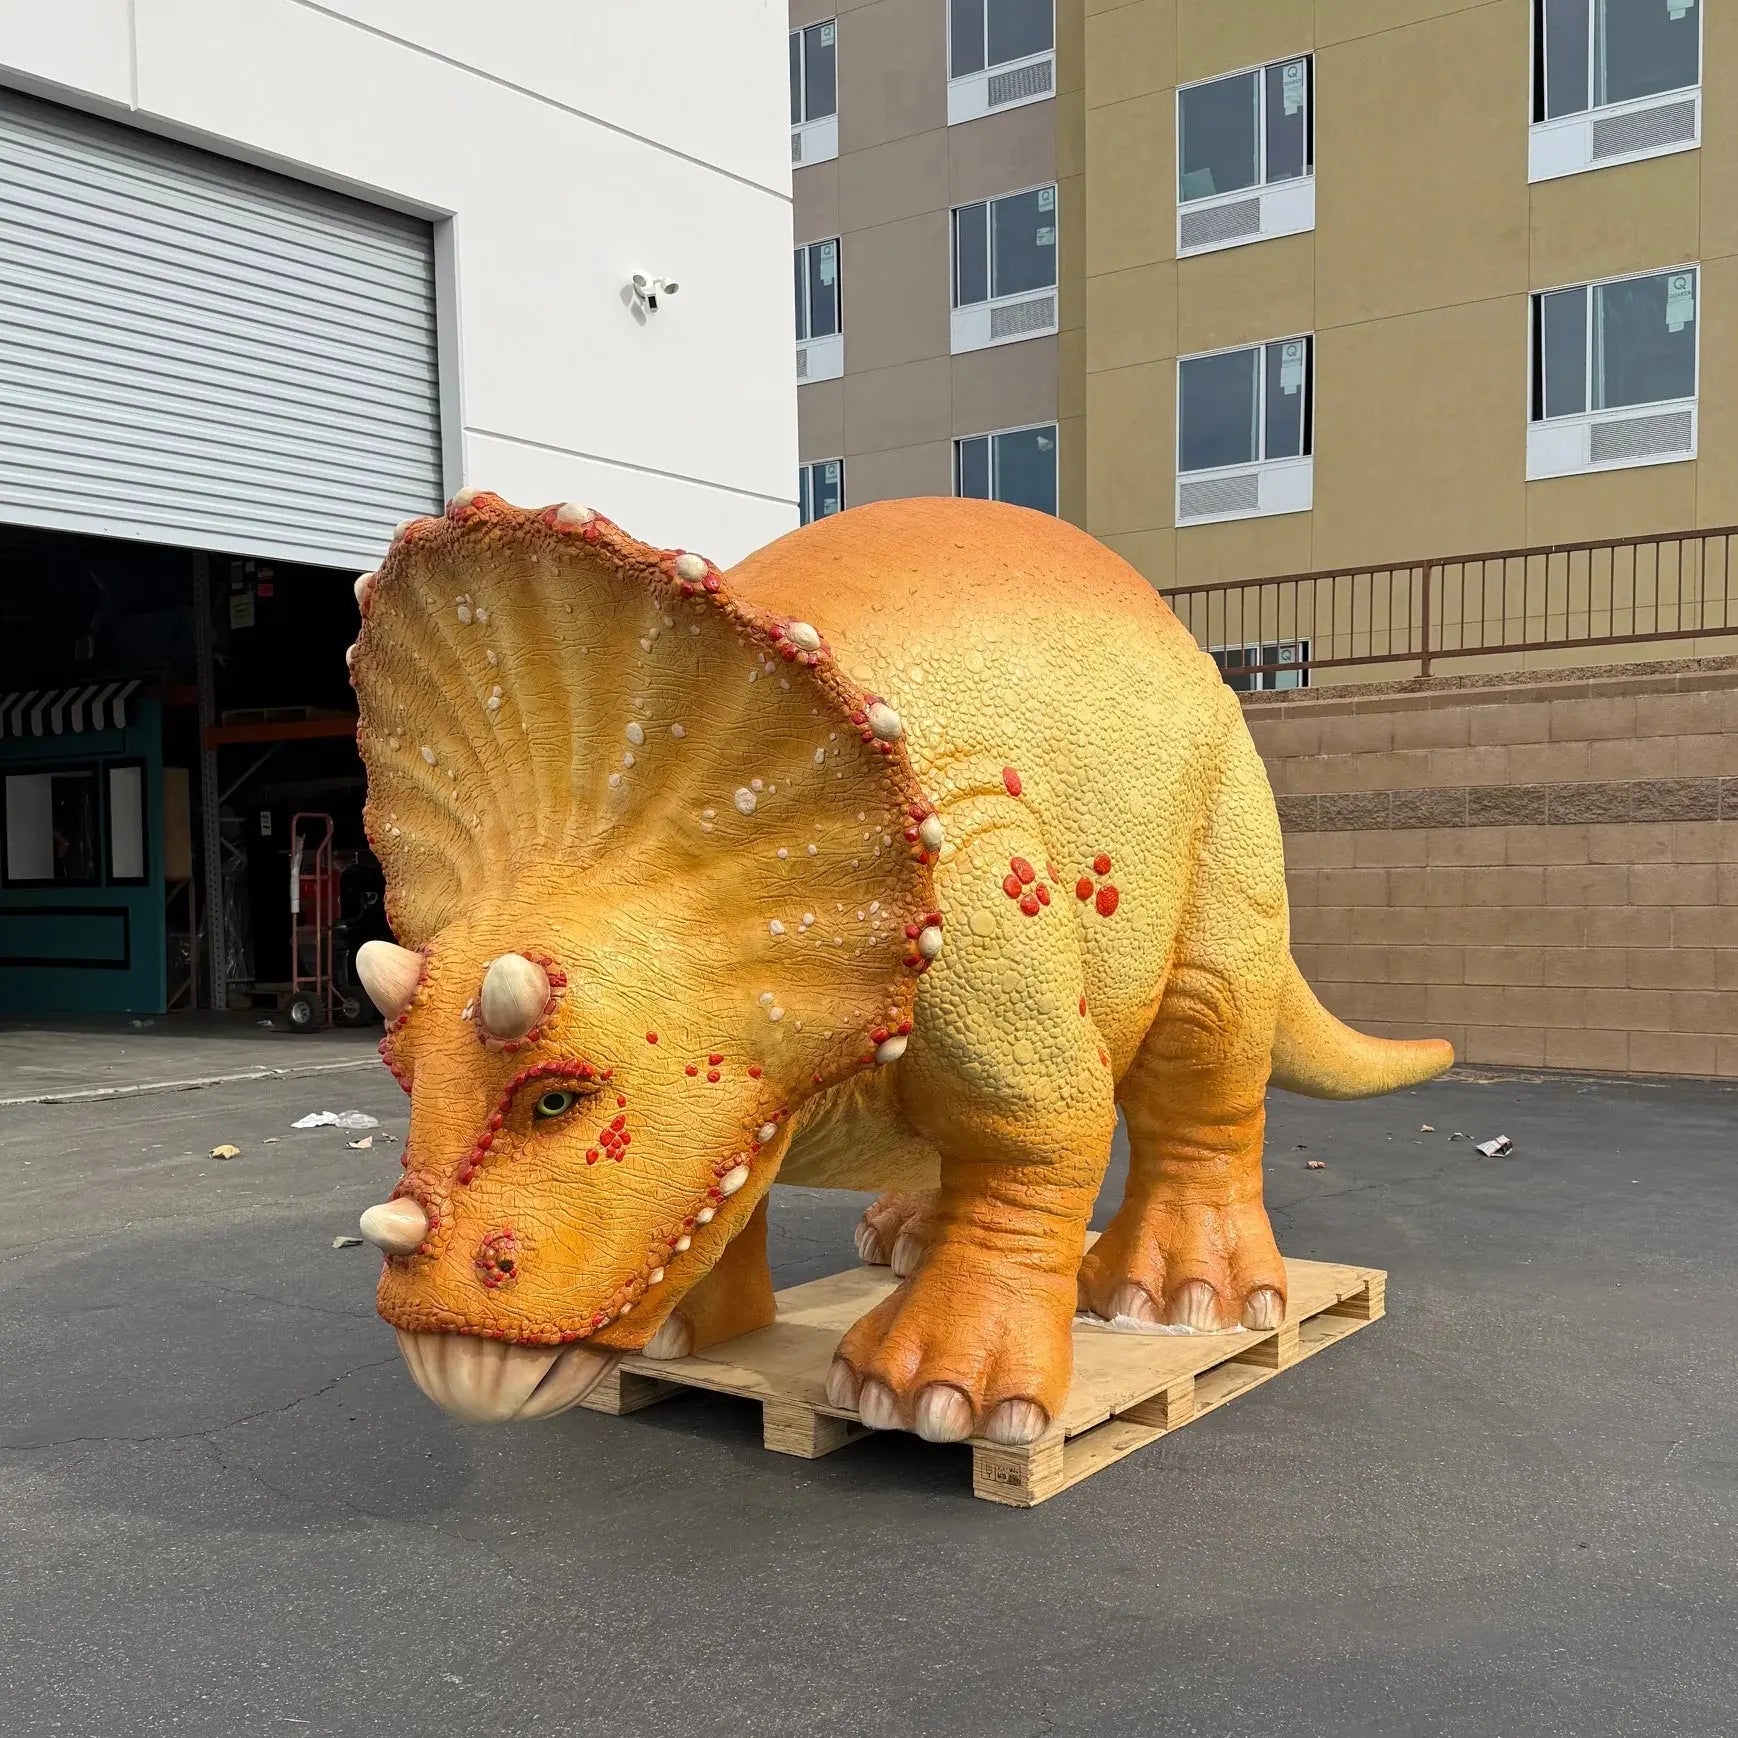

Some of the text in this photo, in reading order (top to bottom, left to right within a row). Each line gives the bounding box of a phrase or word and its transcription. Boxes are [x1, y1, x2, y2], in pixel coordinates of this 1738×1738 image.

[1287, 65, 1298, 78] Q
[1041, 191, 1050, 201] Q
[1674, 277, 1687, 290] Q
[1286, 345, 1297, 357] Q
[1281, 649, 1292, 661] Q
